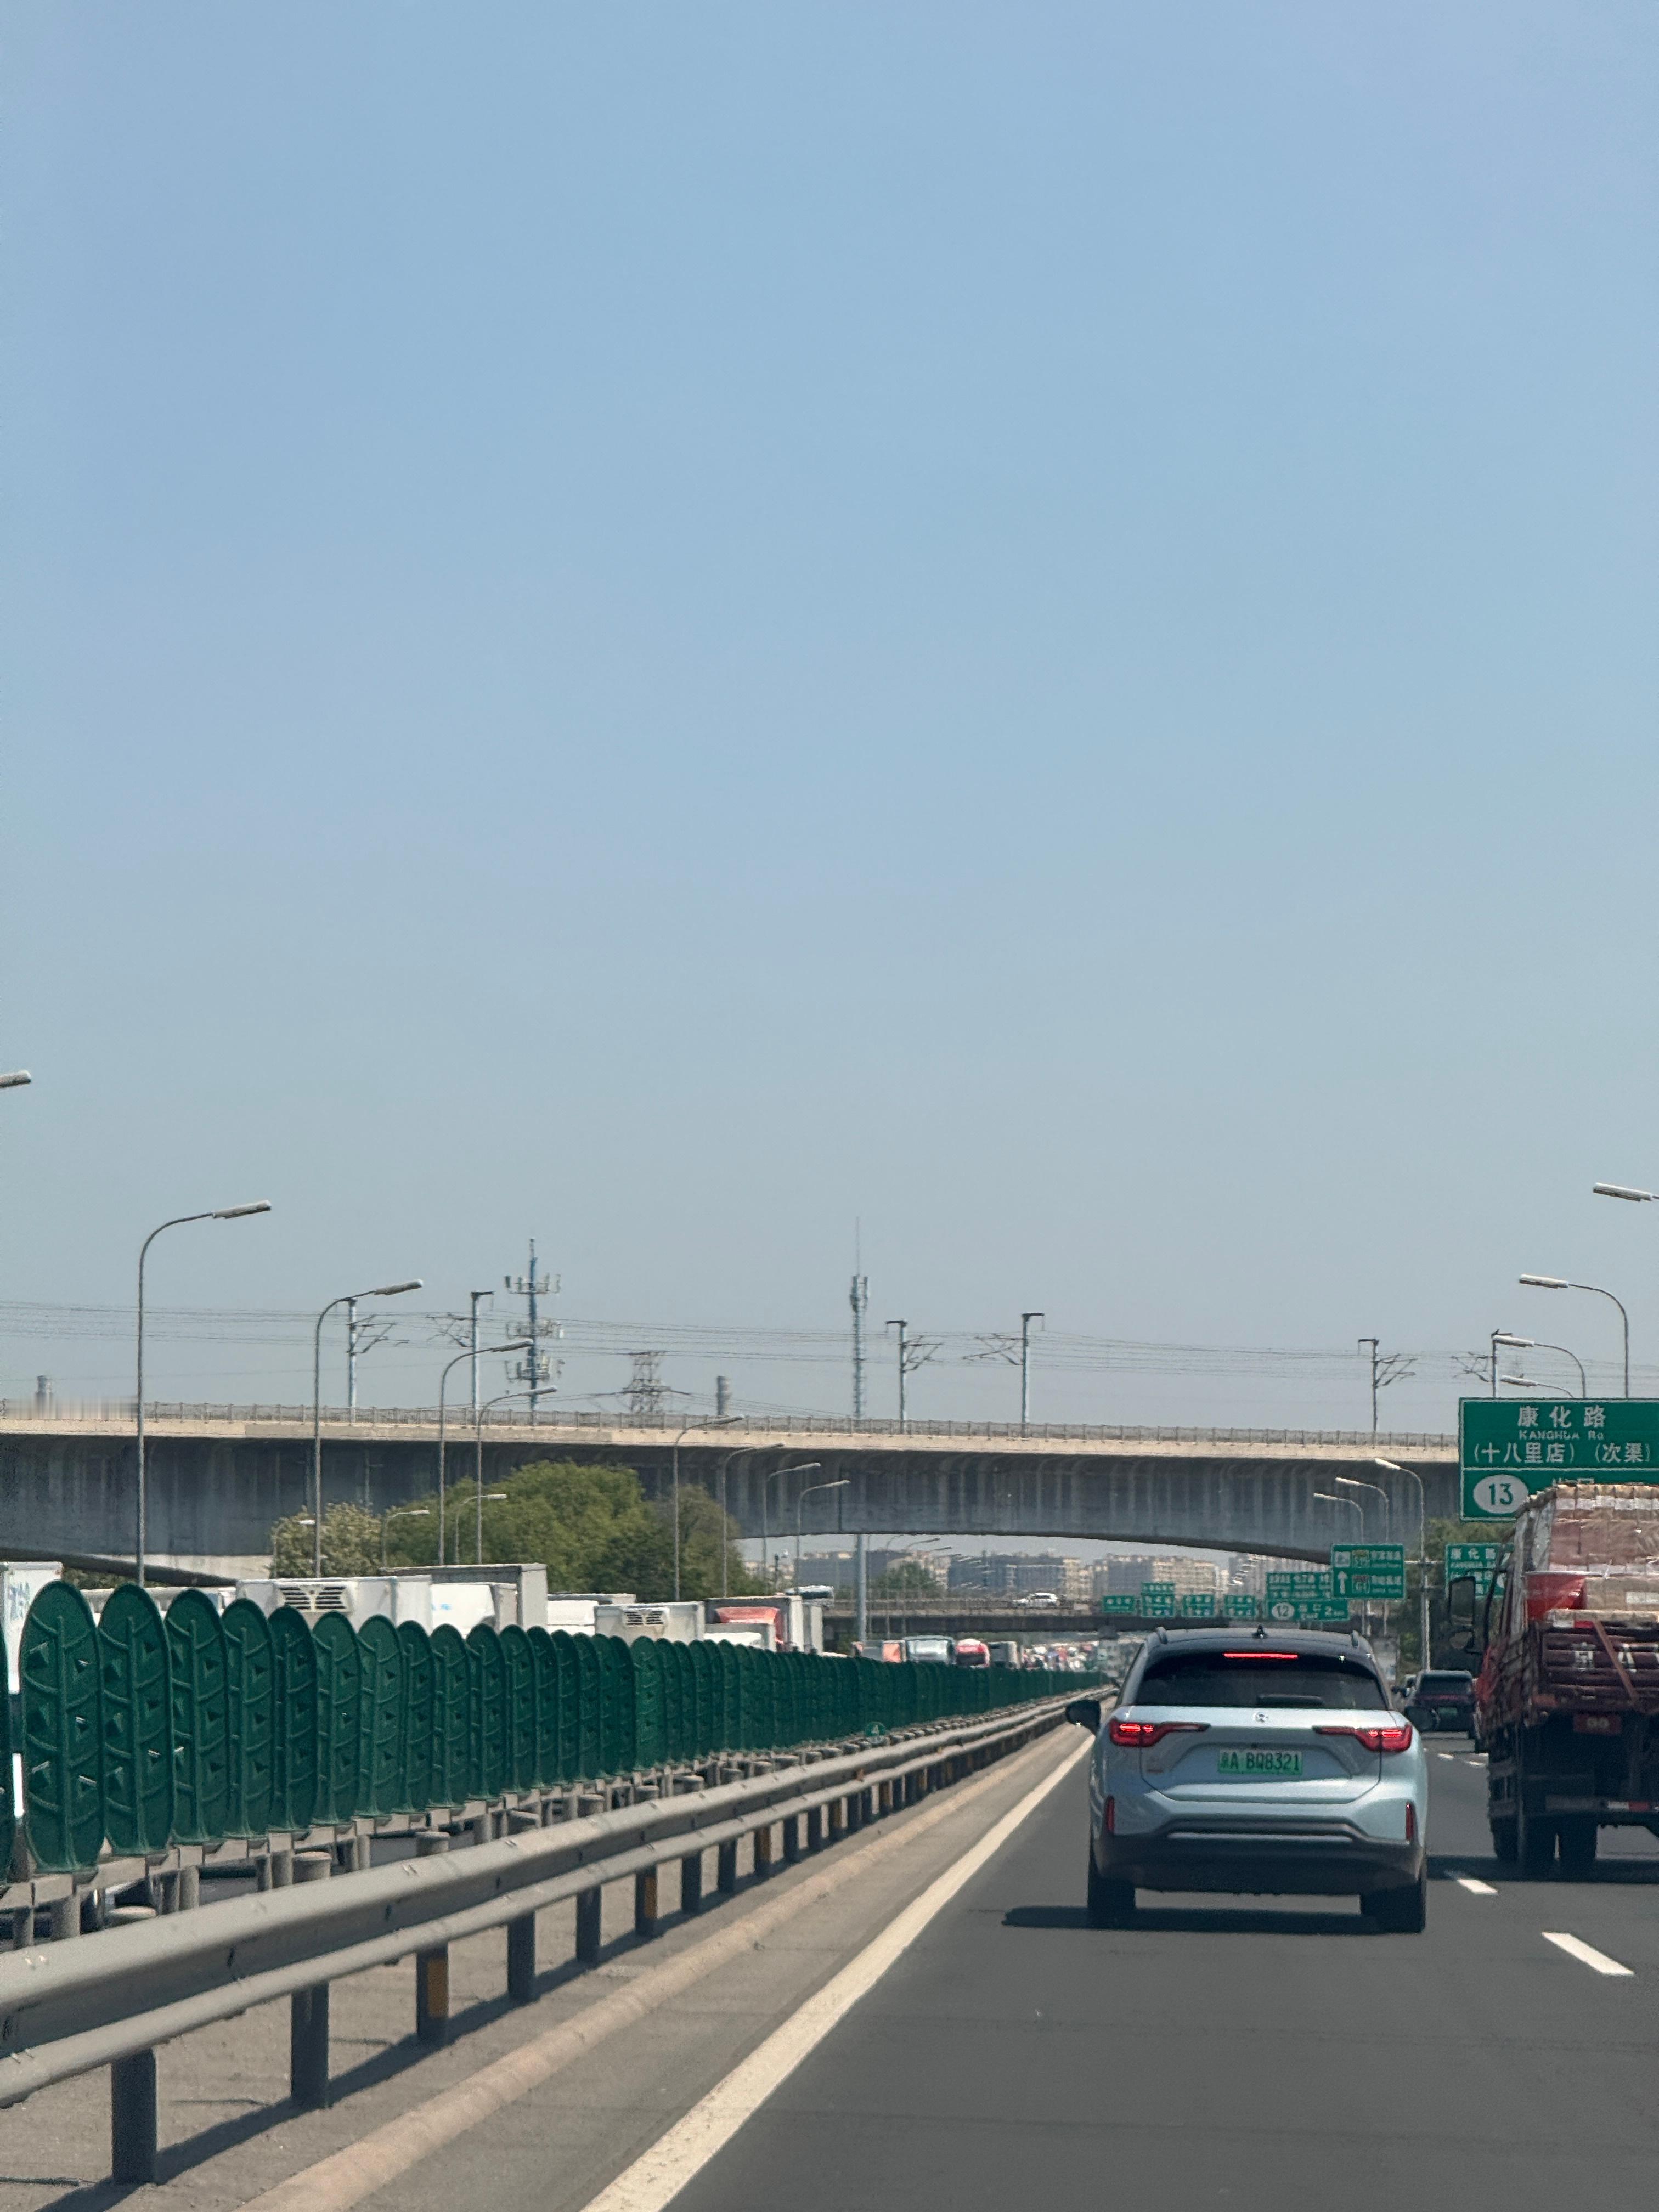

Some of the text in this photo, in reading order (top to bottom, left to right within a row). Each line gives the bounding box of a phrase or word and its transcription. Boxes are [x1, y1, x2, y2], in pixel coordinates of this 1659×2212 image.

[1517, 1405, 1606, 1428] 康化路
[1488, 1483, 1513, 1505] 13
[1277, 1605, 1289, 1617] 12
